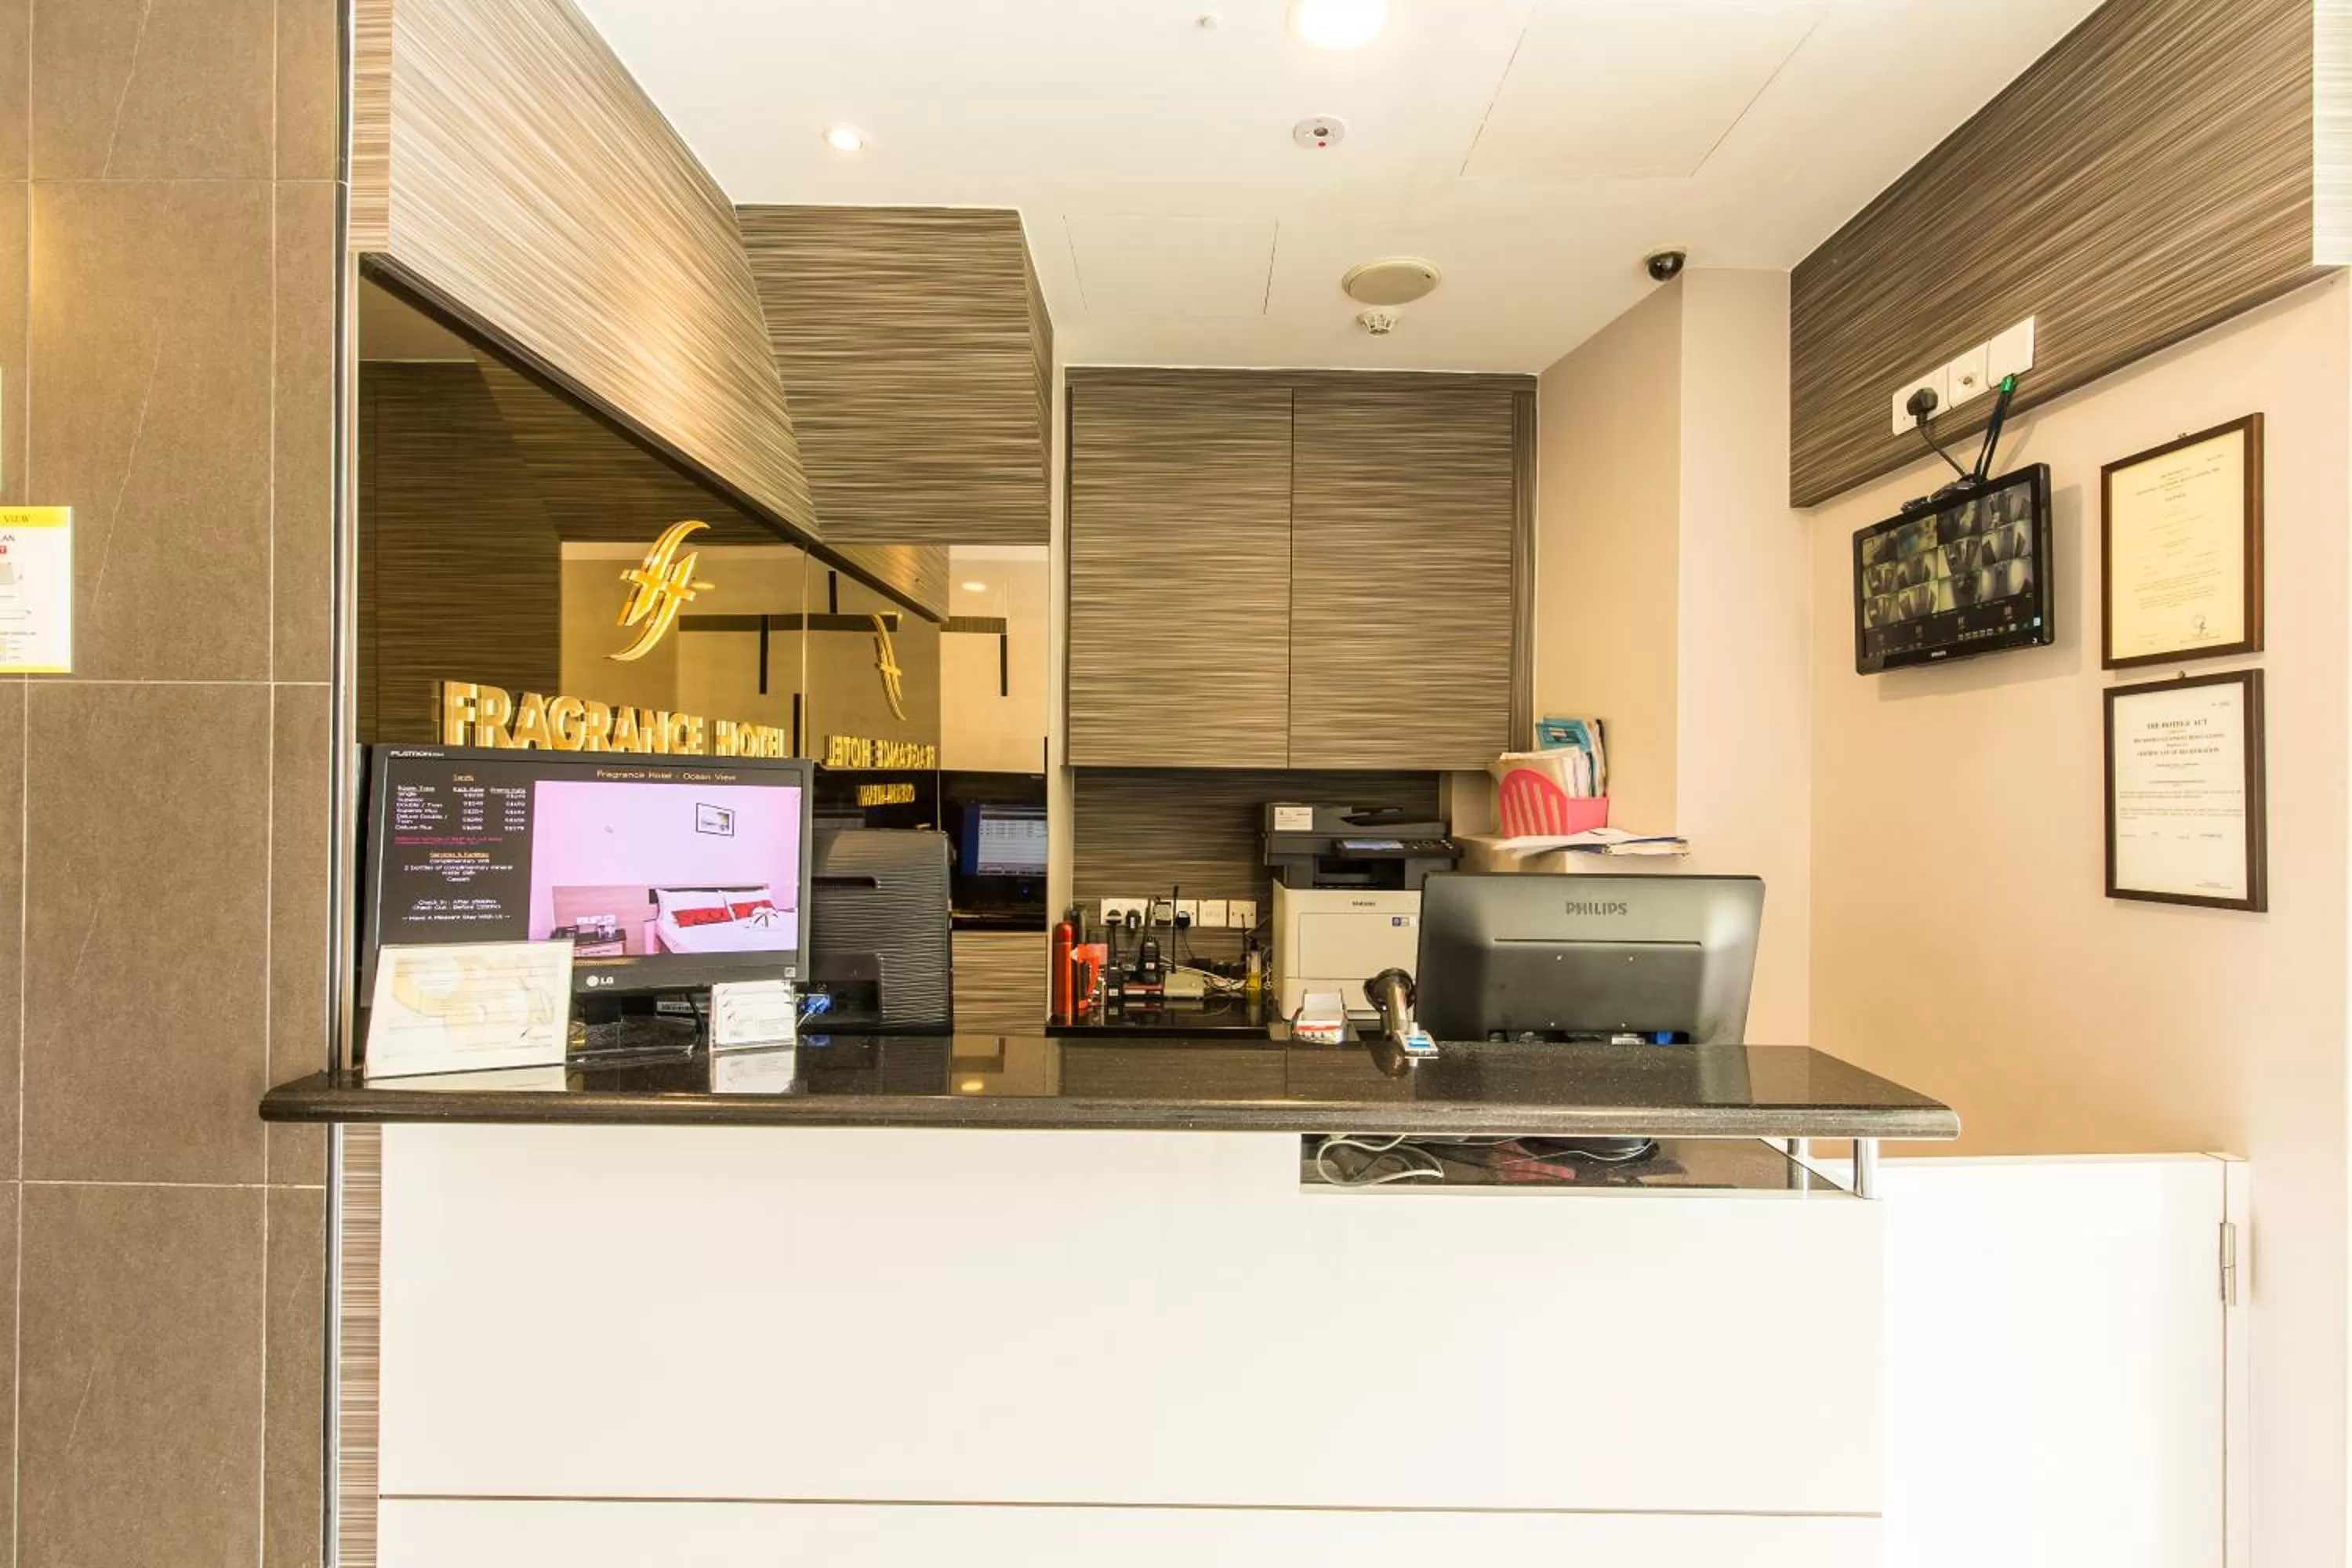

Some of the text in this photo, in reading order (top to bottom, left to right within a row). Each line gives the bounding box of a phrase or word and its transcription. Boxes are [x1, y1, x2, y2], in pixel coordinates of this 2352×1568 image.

[3, 514, 31, 523] VIEW
[443, 681, 785, 757] FRAGRANCE HOTEL
[597, 771, 644, 779] Fragrance
[1566, 902, 1628, 916] PHILIPS
[601, 977, 614, 985] LG
